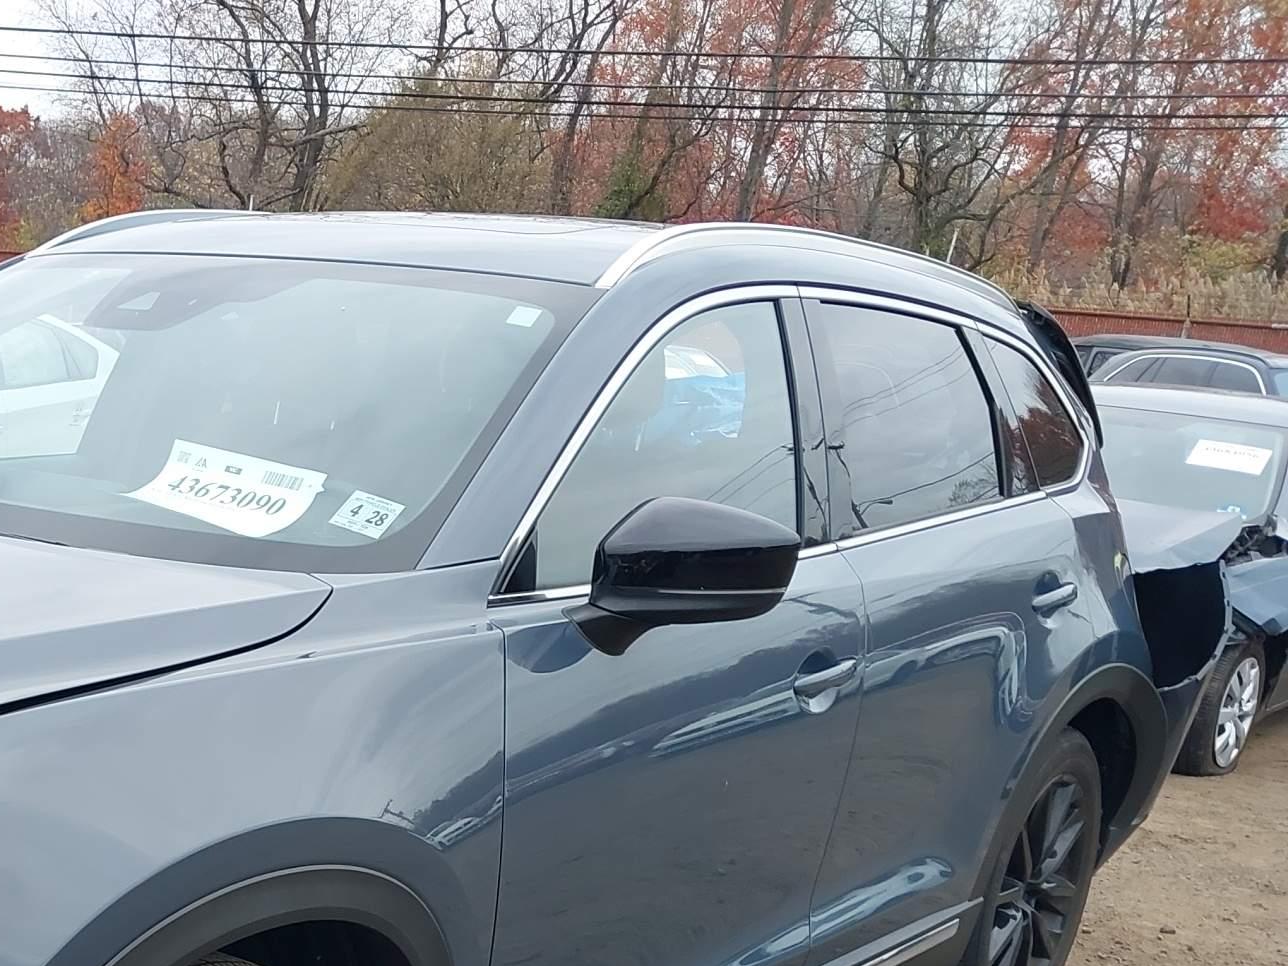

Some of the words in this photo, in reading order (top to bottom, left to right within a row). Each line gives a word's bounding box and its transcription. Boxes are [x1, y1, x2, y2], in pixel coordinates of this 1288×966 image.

[168, 475, 287, 516] 43673090
[350, 504, 364, 517] 4
[365, 510, 389, 526] 28
